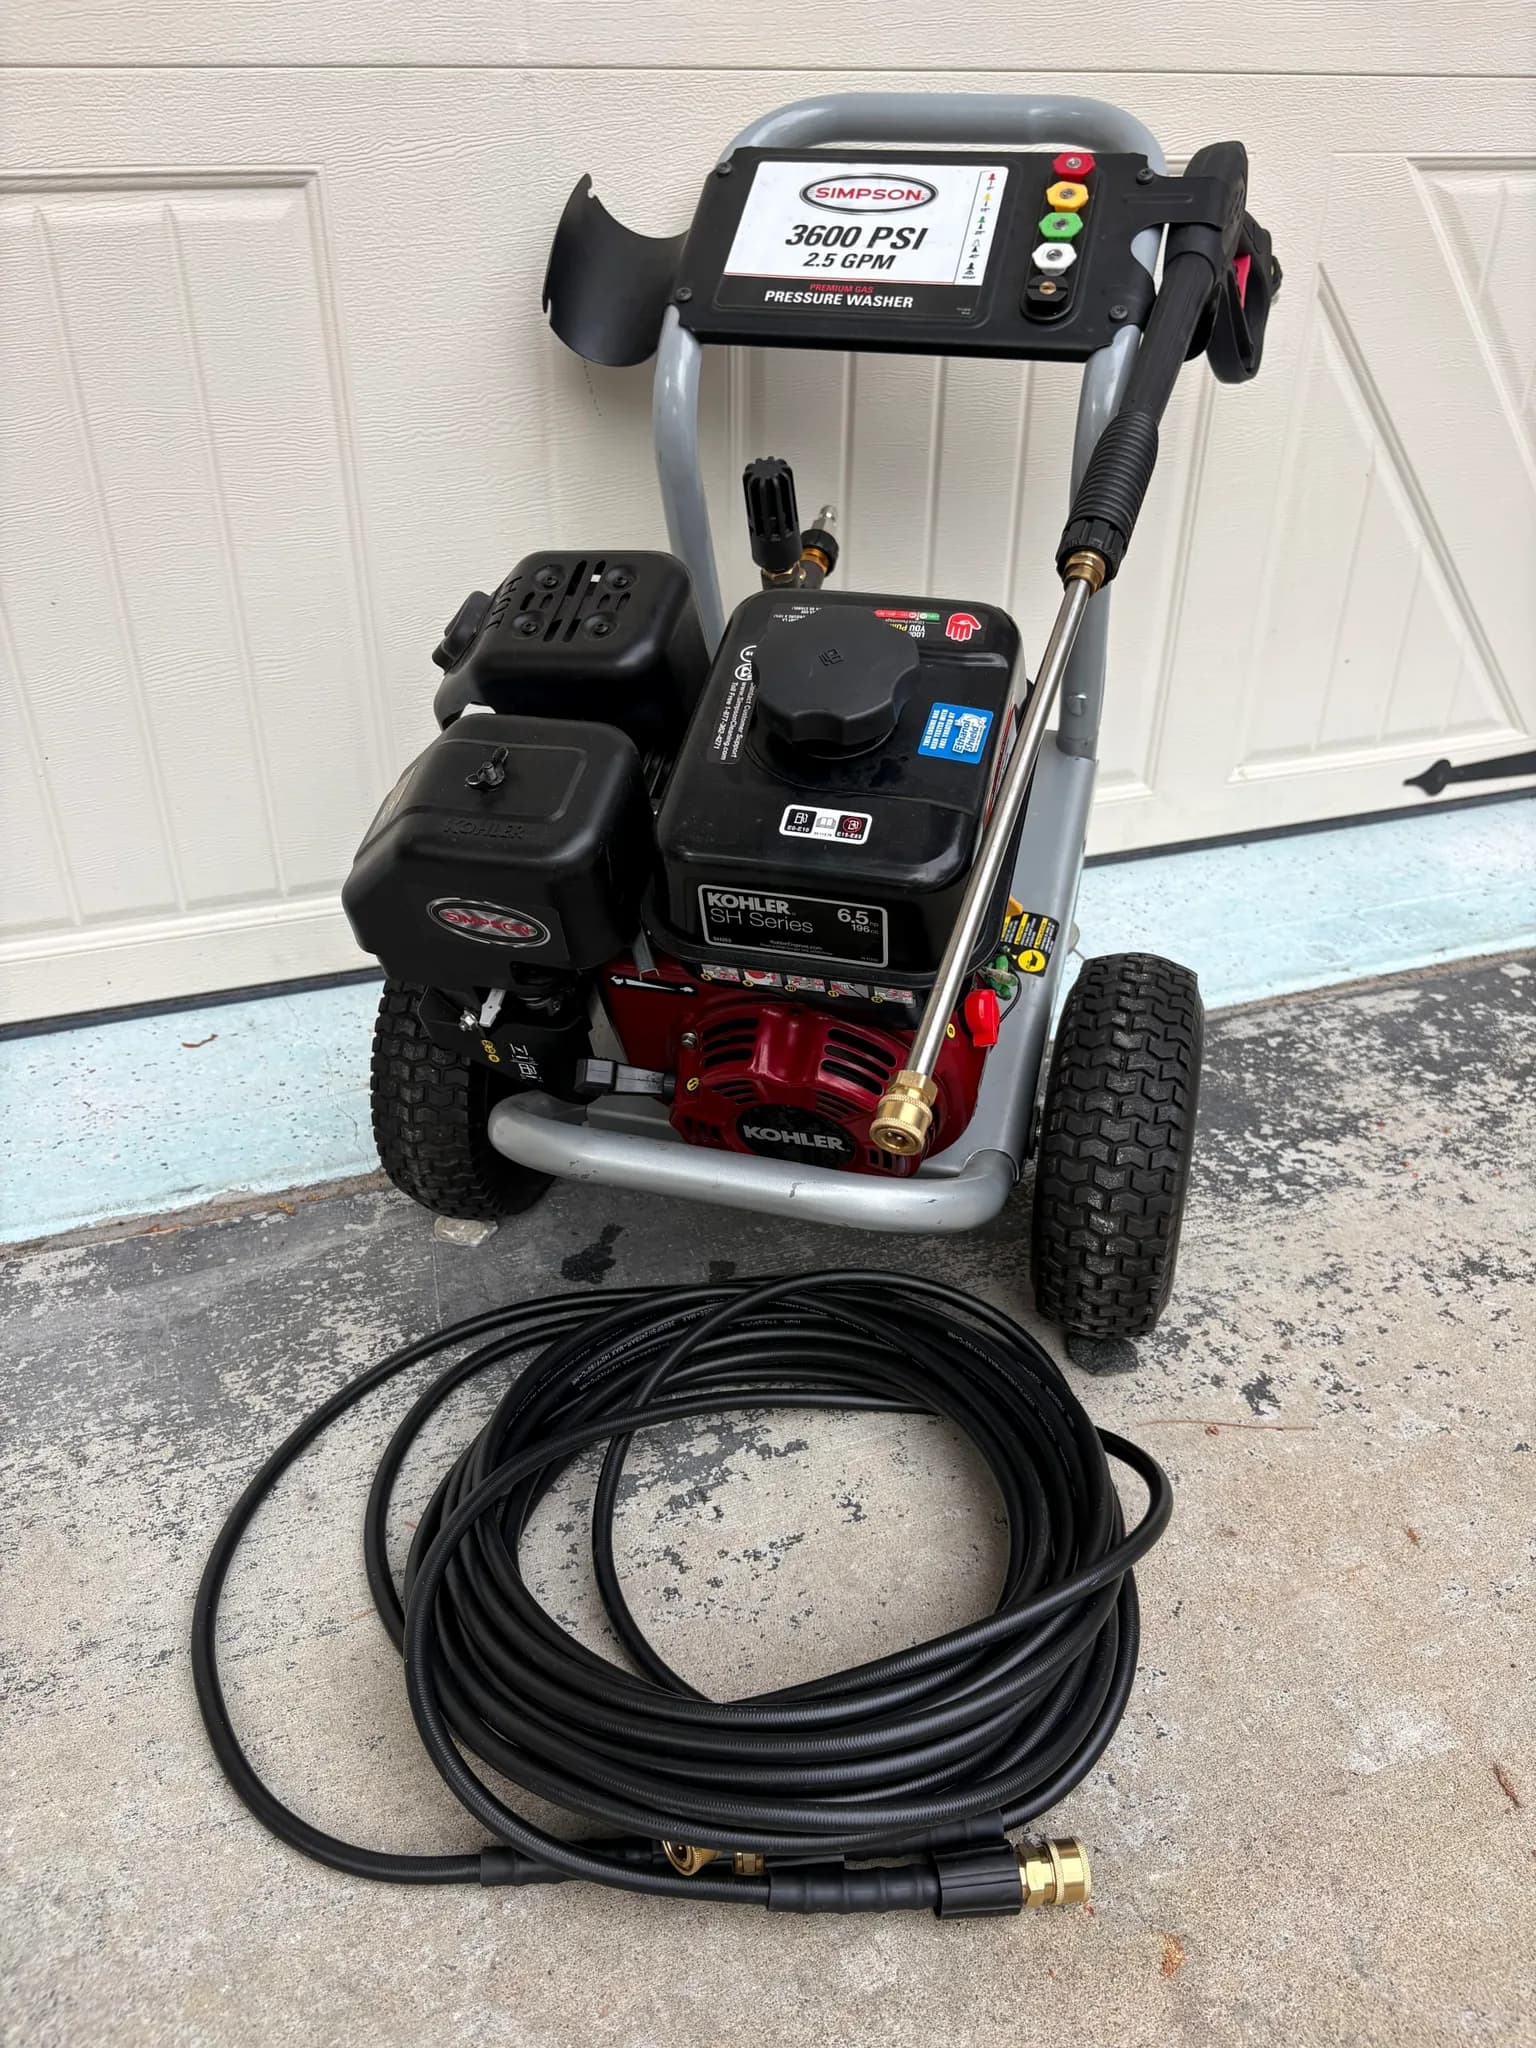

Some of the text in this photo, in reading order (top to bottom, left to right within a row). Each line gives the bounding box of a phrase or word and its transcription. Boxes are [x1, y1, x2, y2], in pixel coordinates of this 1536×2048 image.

[815, 187, 922, 201] SIMPSON
[784, 224, 929, 250] 3600 PSI
[802, 252, 896, 270] 2.5 GPM
[764, 290, 914, 308] PRESSURE WASHER
[809, 283, 875, 294] PREMIUM GAS
[908, 624, 925, 632] YOU
[725, 691, 736, 705] Free
[731, 733, 744, 758] Support
[954, 720, 971, 751] Ethanol
[965, 726, 979, 751] Shield
[706, 892, 791, 916] KOHLER
[444, 911, 532, 937] SIMPSON
[710, 908, 814, 934] SH Series
[836, 908, 870, 925] 6.5
[850, 924, 870, 934] 196
[743, 1125, 845, 1151] KOHLER
